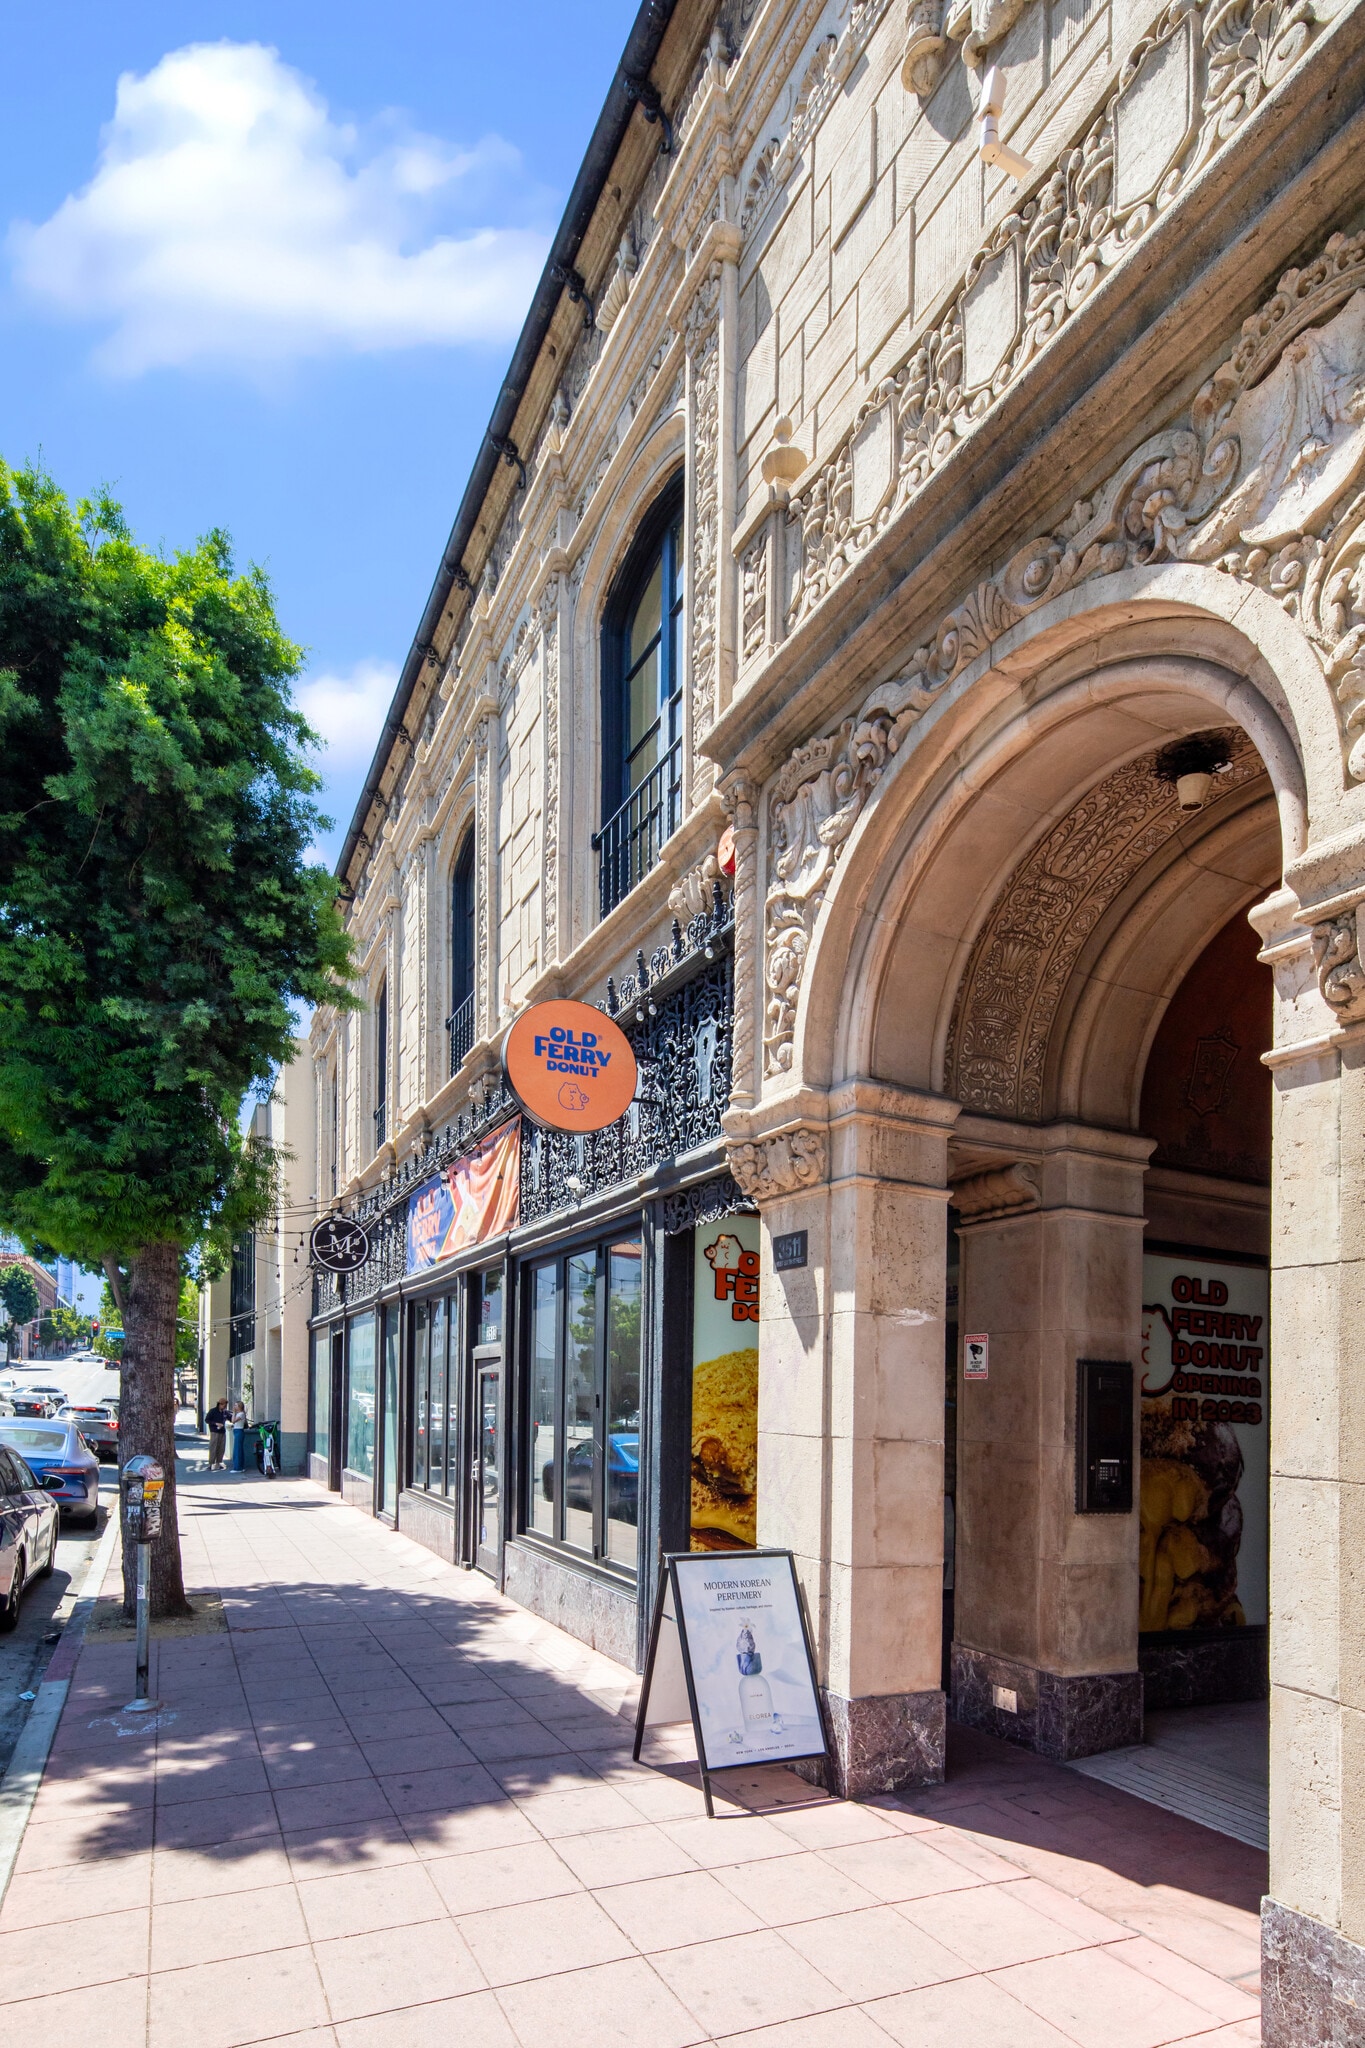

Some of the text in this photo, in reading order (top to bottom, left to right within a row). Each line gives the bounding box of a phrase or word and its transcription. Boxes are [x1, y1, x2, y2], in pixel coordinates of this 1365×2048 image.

[549, 1026, 598, 1048] OLD
[534, 1035, 612, 1067] FERRY
[546, 1060, 600, 1078] DONUT
[1171, 1275, 1229, 1307] OLD
[1171, 1307, 1263, 1341] FERRY
[1171, 1339, 1264, 1372] DONUT
[1171, 1371, 1262, 1398] OPENING
[1171, 1397, 1263, 1425] IN 2023
[703, 1579, 772, 1590] MODERN KOREAN
[717, 1590, 762, 1601] PERFUMERY
